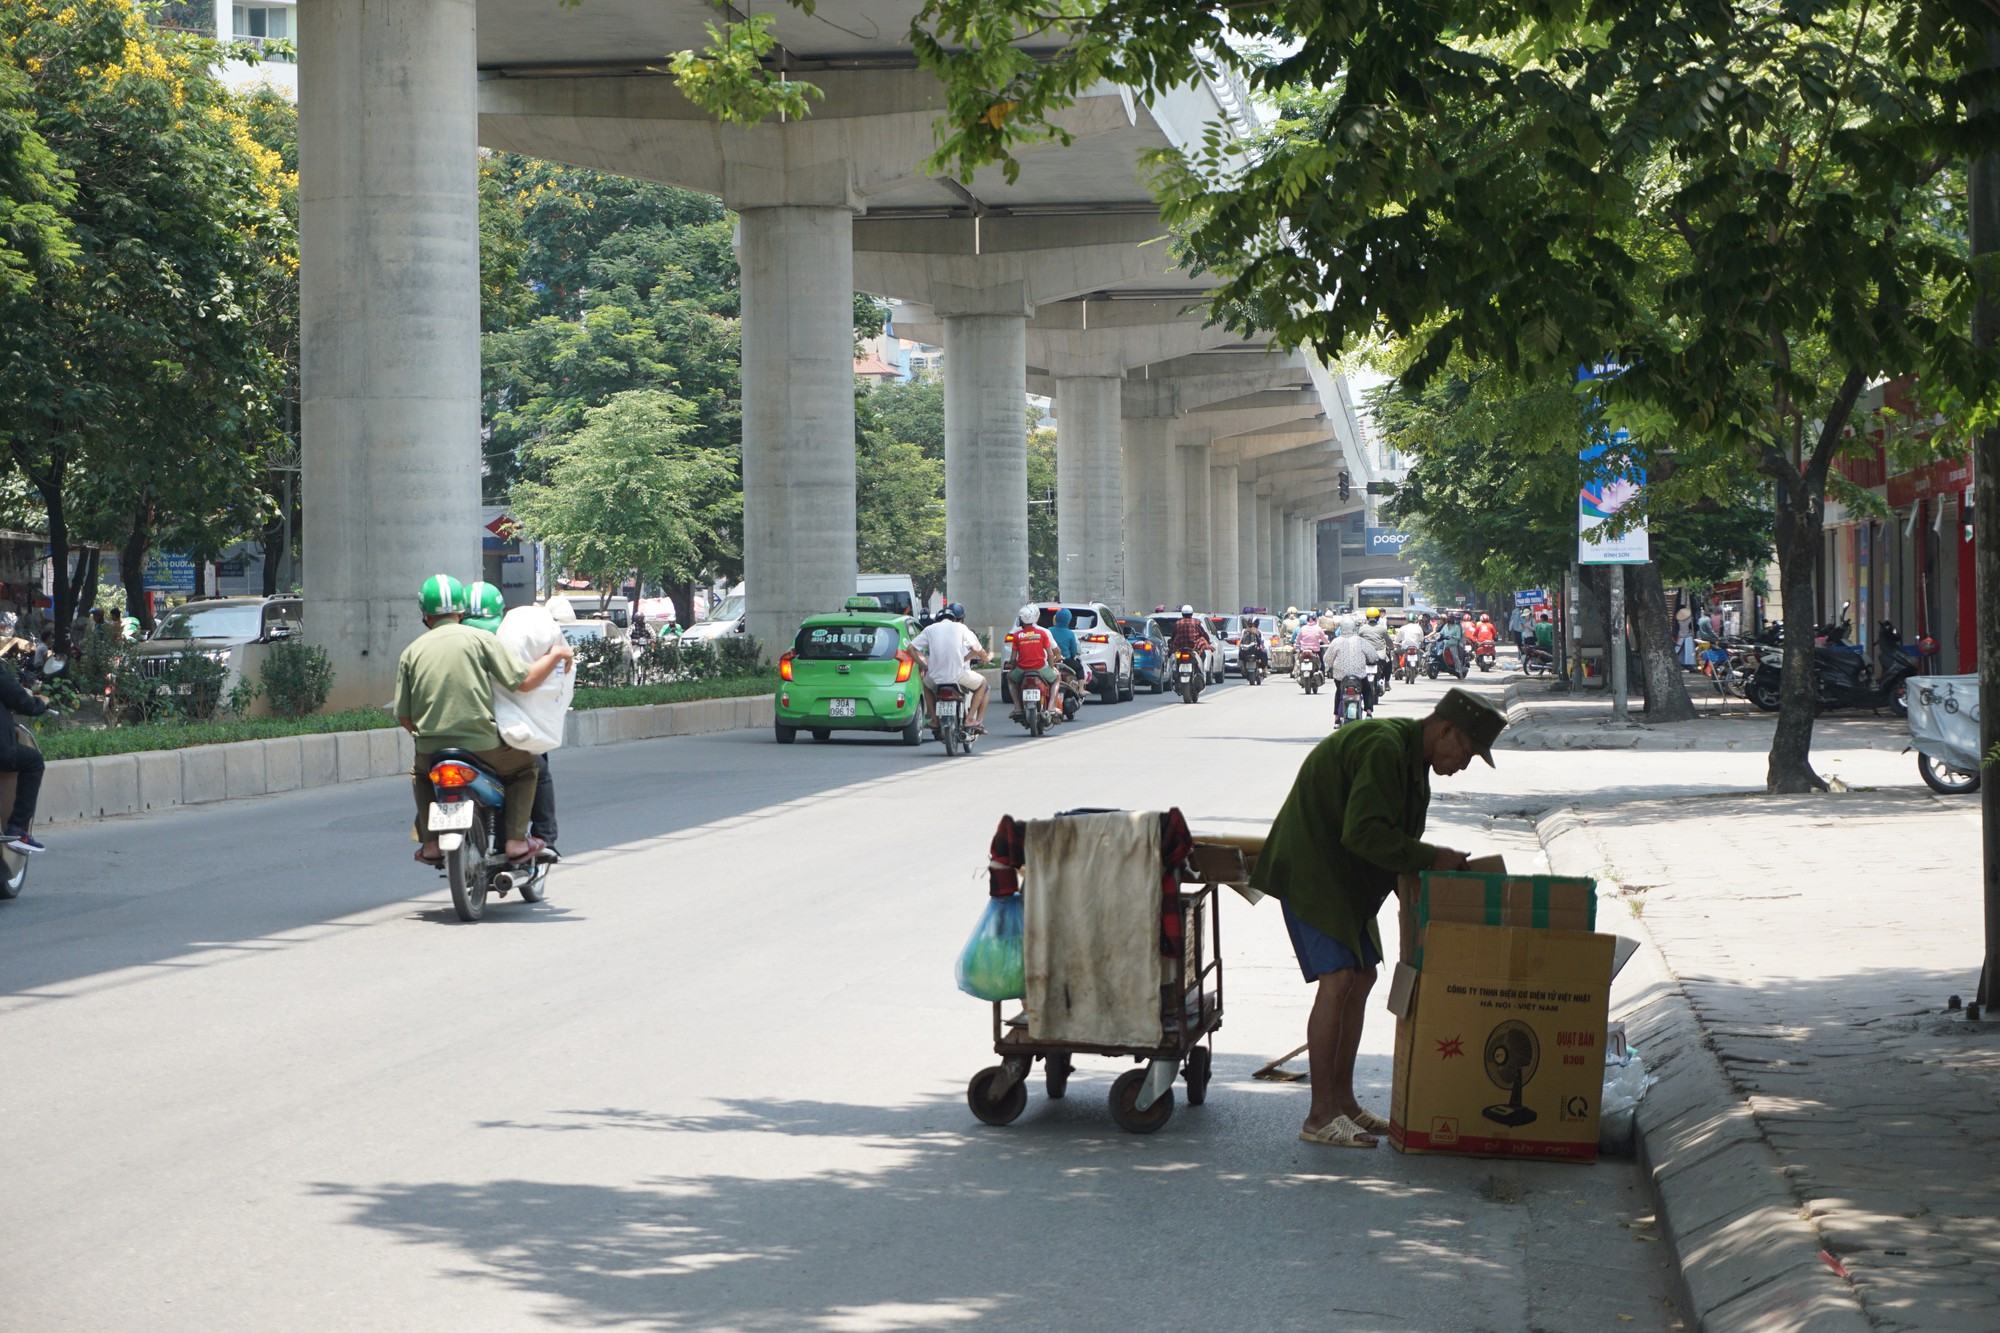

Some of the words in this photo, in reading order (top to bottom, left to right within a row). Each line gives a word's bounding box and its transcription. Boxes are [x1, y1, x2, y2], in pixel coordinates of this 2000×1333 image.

[830, 708, 855, 716] 096.19
[1446, 984, 1467, 994] CÔNG
[1479, 987, 1498, 997] TNHH
[1500, 989, 1517, 999] ĐIỆN
[1518, 989, 1529, 998] CƠ
[1529, 990, 1546, 1001] ĐIỆN
[1548, 990, 1556, 1001] TỬ
[1557, 992, 1572, 1003] VIỆT
[1573, 994, 1591, 1004] NHẬT
[1480, 1000, 1493, 1008] HÀ
[1495, 1001, 1511, 1010] NỘI
[1518, 1003, 1536, 1012] VIỆT
[1538, 1004, 1559, 1012] NAM
[1557, 1032, 1576, 1048] QUẠT
[1578, 1030, 1594, 1046] BÀN
[1563, 1055, 1585, 1065] B300
